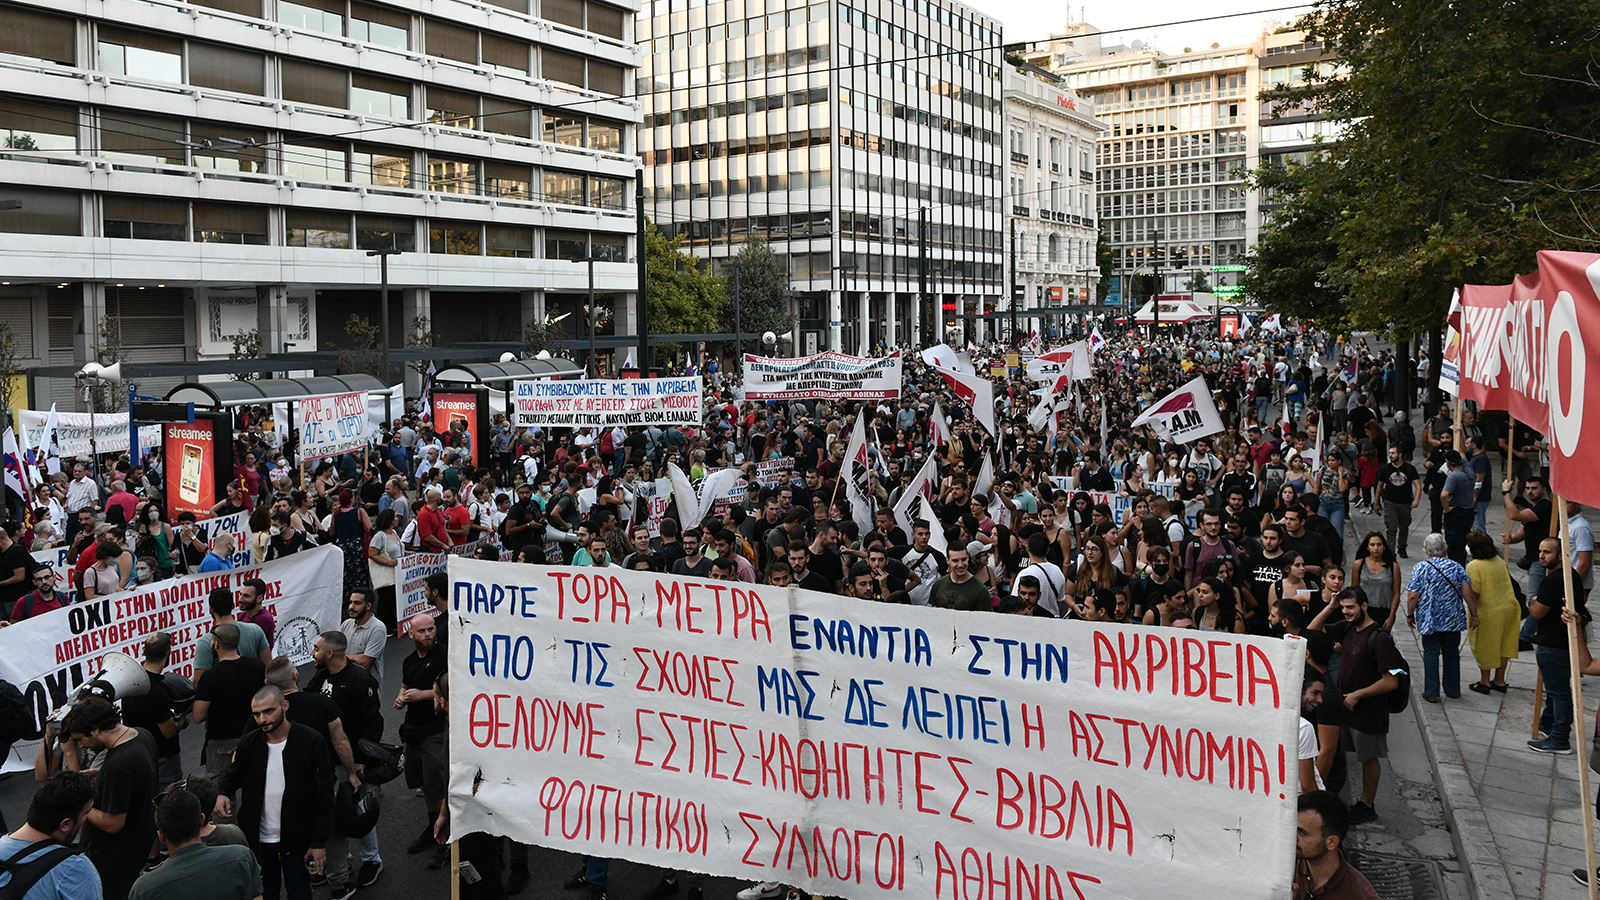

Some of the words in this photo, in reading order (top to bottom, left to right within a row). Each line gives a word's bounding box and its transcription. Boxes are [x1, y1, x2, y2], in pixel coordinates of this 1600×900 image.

[763, 374, 776, 382] ΣΤΑ
[777, 373, 798, 382] ΜΕΤΡΑ
[800, 371, 814, 380] ΤΗΣ
[518, 383, 533, 396] ΔΕΝ
[536, 382, 607, 396] ΣΥΜΒΙΒΑΖΟΜΑΣΤΕ
[612, 383, 628, 396] ΜΕ
[631, 382, 650, 396] ΤΗΝ
[656, 379, 697, 395] ΑΚΡΙΒΕΙΑ
[786, 382, 797, 390] ΜΕ
[518, 398, 554, 411] ΥΠΟΓΡΑΦΗ
[556, 398, 572, 411] ΣΣΕ
[573, 398, 584, 411] ΜΕ
[586, 398, 626, 411] ΑΥΞΗΣΕΙΣ
[630, 397, 657, 411] ΣΤΟΥΣ
[660, 395, 698, 409] ΜΙΣΘΟΥΣ
[762, 391, 811, 399] ΣΥΝΔΙΚΑΤΟ
[436, 399, 475, 411] streamee
[666, 410, 698, 423] ΕΛΛΑΔΑΣ
[168, 425, 212, 441] streamee
[68, 599, 112, 635] ΟΧΙ
[114, 590, 156, 620] ΣΤΗΝ
[159, 573, 231, 608] ΠΟΛΙΤΙΚΗ
[55, 608, 176, 665] ΑΠΕΛΕΥΘΕΡΩΣΗΣ
[178, 600, 205, 623] ΤΗΣ
[454, 581, 539, 618] ΠΑΡΤΕ
[655, 580, 772, 643] ΜΕΤΡΑ
[790, 614, 932, 667] ΕΝΑΝΤΙΑ
[968, 634, 1069, 684] ΣΤΗΝ
[1093, 630, 1280, 709] ΑΚΡΙΒΕΙΑ
[469, 633, 535, 682] ΑΠΟ
[564, 638, 614, 687] ΤΙΣ
[633, 646, 745, 707] ΣΧΟΛΕΣ
[757, 664, 826, 722] ΜΑΣ
[845, 678, 889, 728] ΔΕ
[902, 685, 1012, 747] ΛΕΙΠΕΙ
[1021, 703, 1045, 751] Η
[1069, 709, 1287, 800] ΑΣΤΥΝΟΜΙΑ!
[469, 693, 606, 760] ΘΕΛΟΥΜΕ
[539, 776, 708, 857] ΦΟΙΤΗΤΙΚΟΙ
[738, 811, 904, 892] ΣΥΛΛΟΓΟΙ
